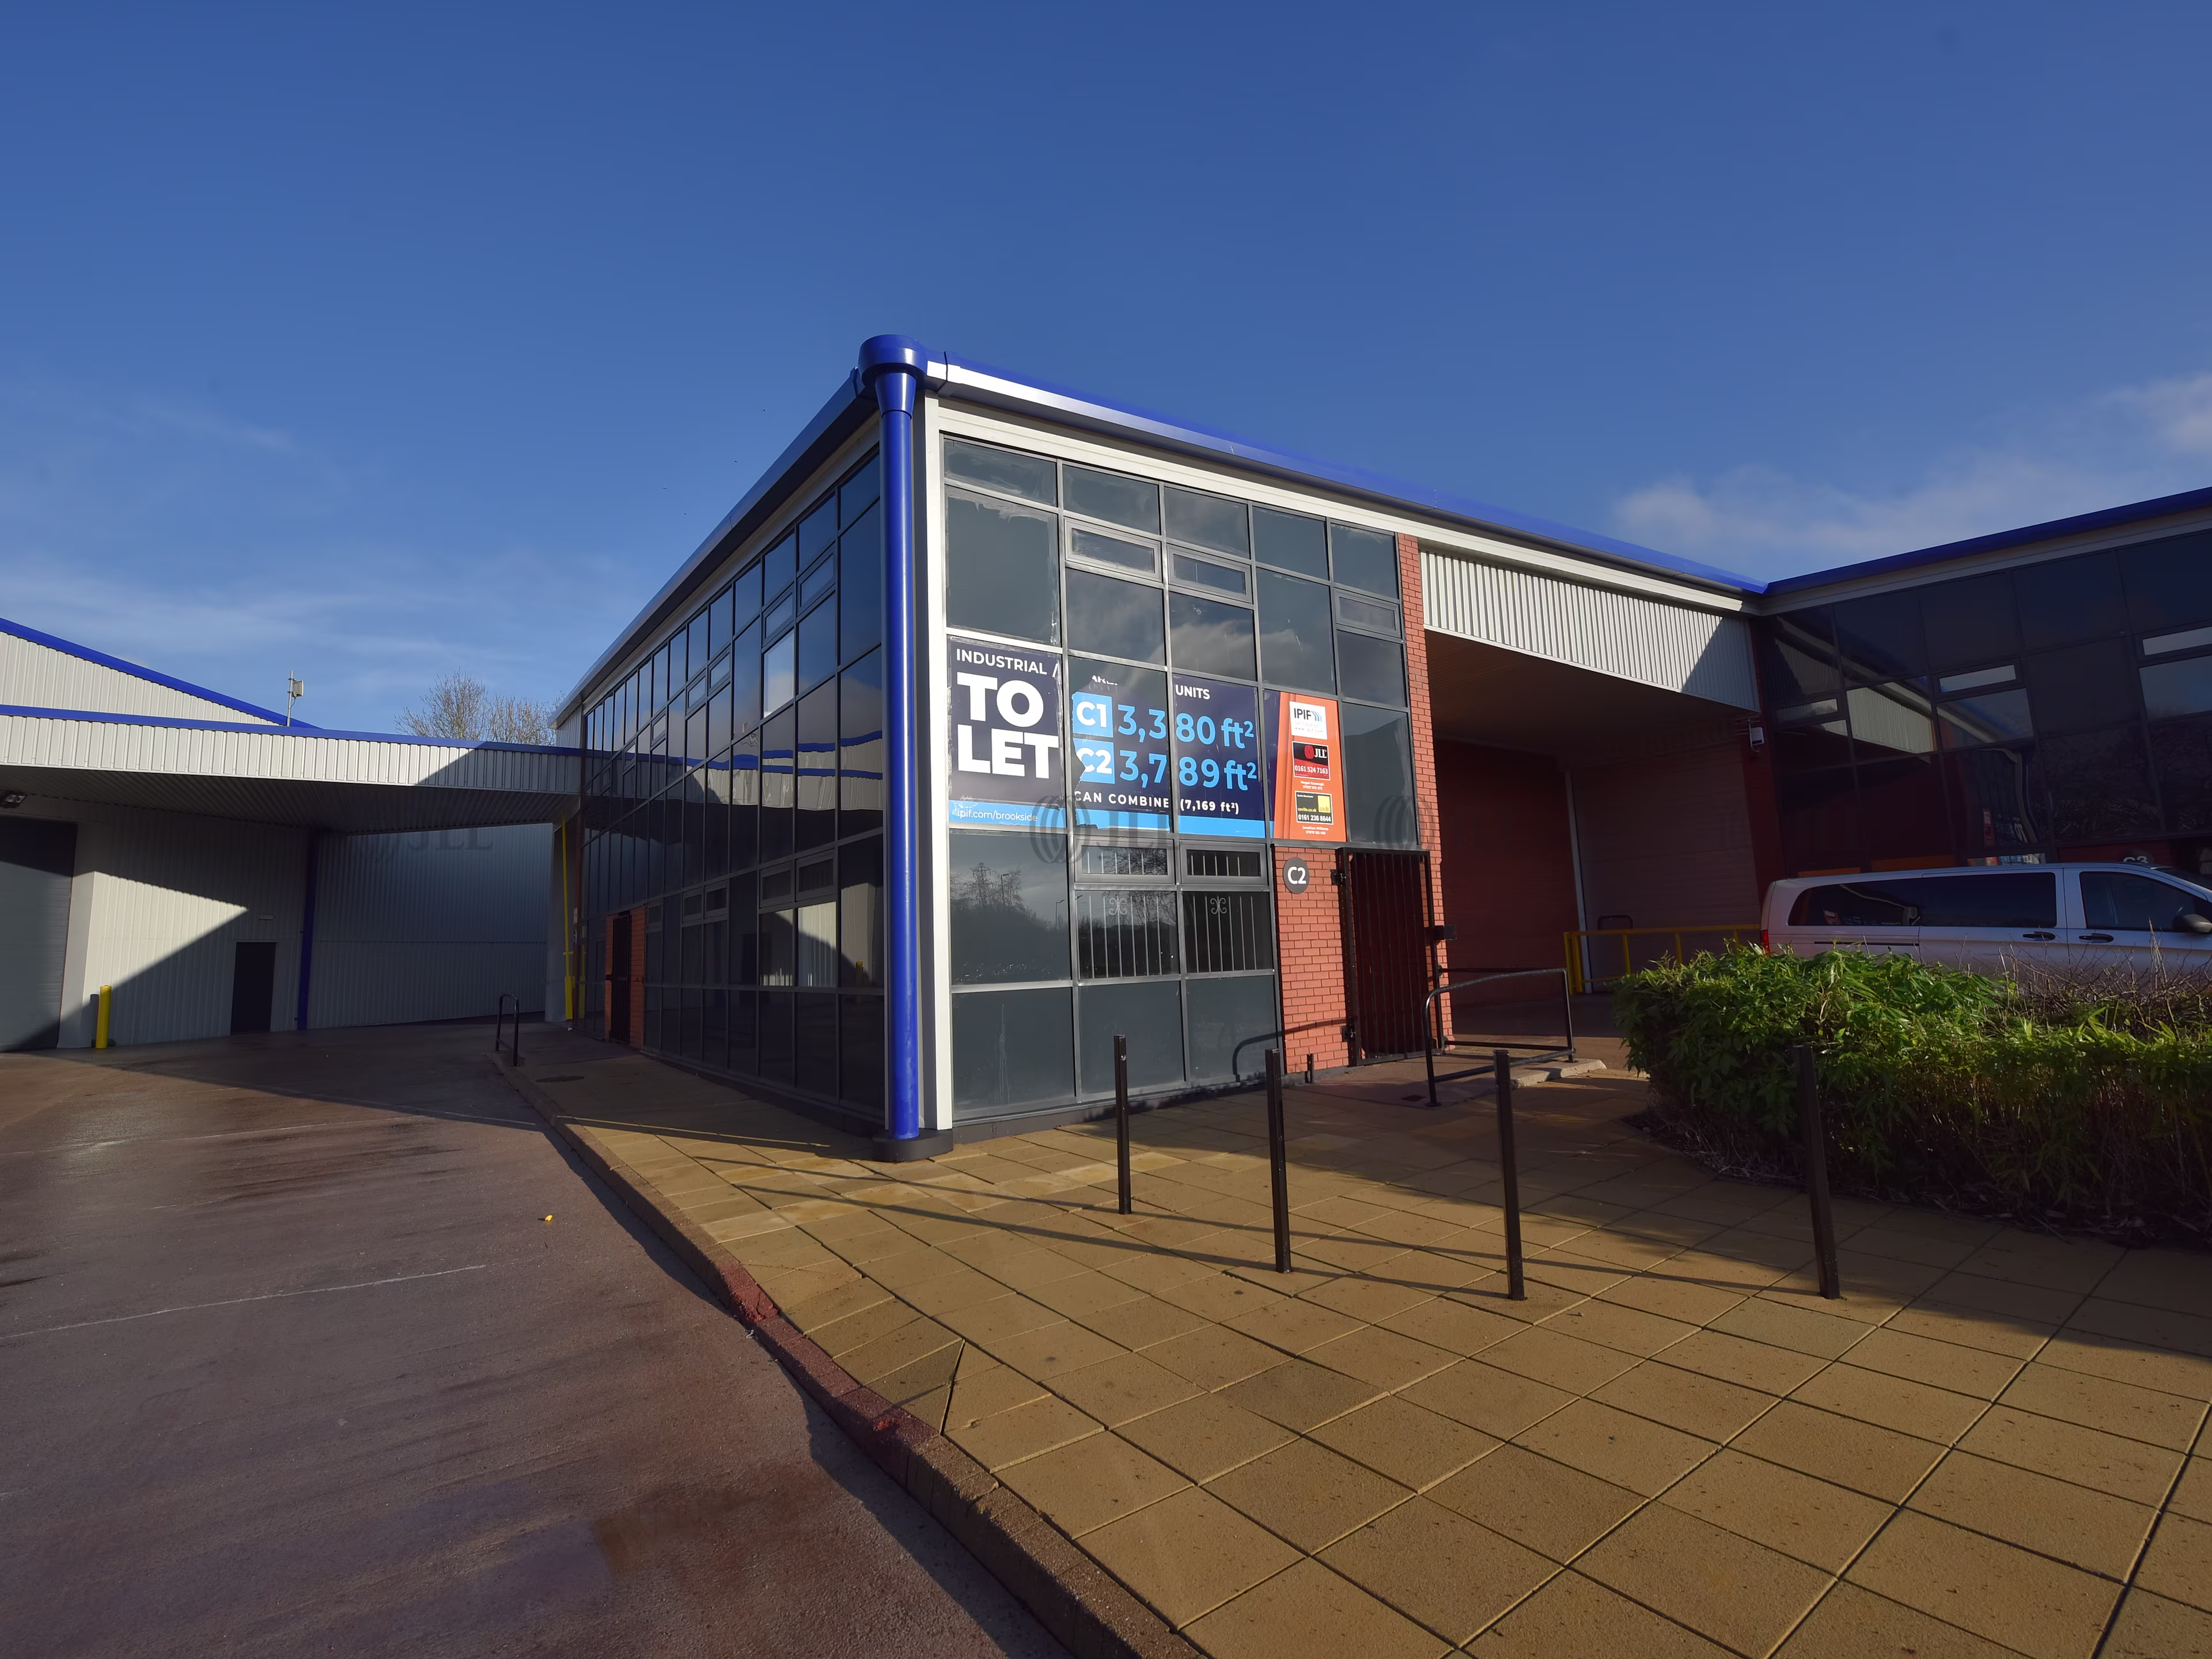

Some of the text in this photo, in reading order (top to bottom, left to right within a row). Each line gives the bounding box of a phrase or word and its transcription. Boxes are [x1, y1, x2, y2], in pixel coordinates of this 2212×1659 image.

[956, 649, 1047, 675] INDUSTRIAL
[957, 672, 1044, 728] TO
[1175, 684, 1210, 699] UNITS
[1076, 701, 1107, 728] C1
[1294, 708, 1312, 720] IPIF
[957, 724, 1059, 779] LET
[1076, 747, 1112, 774] C2
[1074, 791, 1102, 803] CAN
[1108, 793, 1169, 808] COMBINE
[957, 809, 1037, 821] ipif.com/brookside
[1287, 866, 1306, 884] C2
